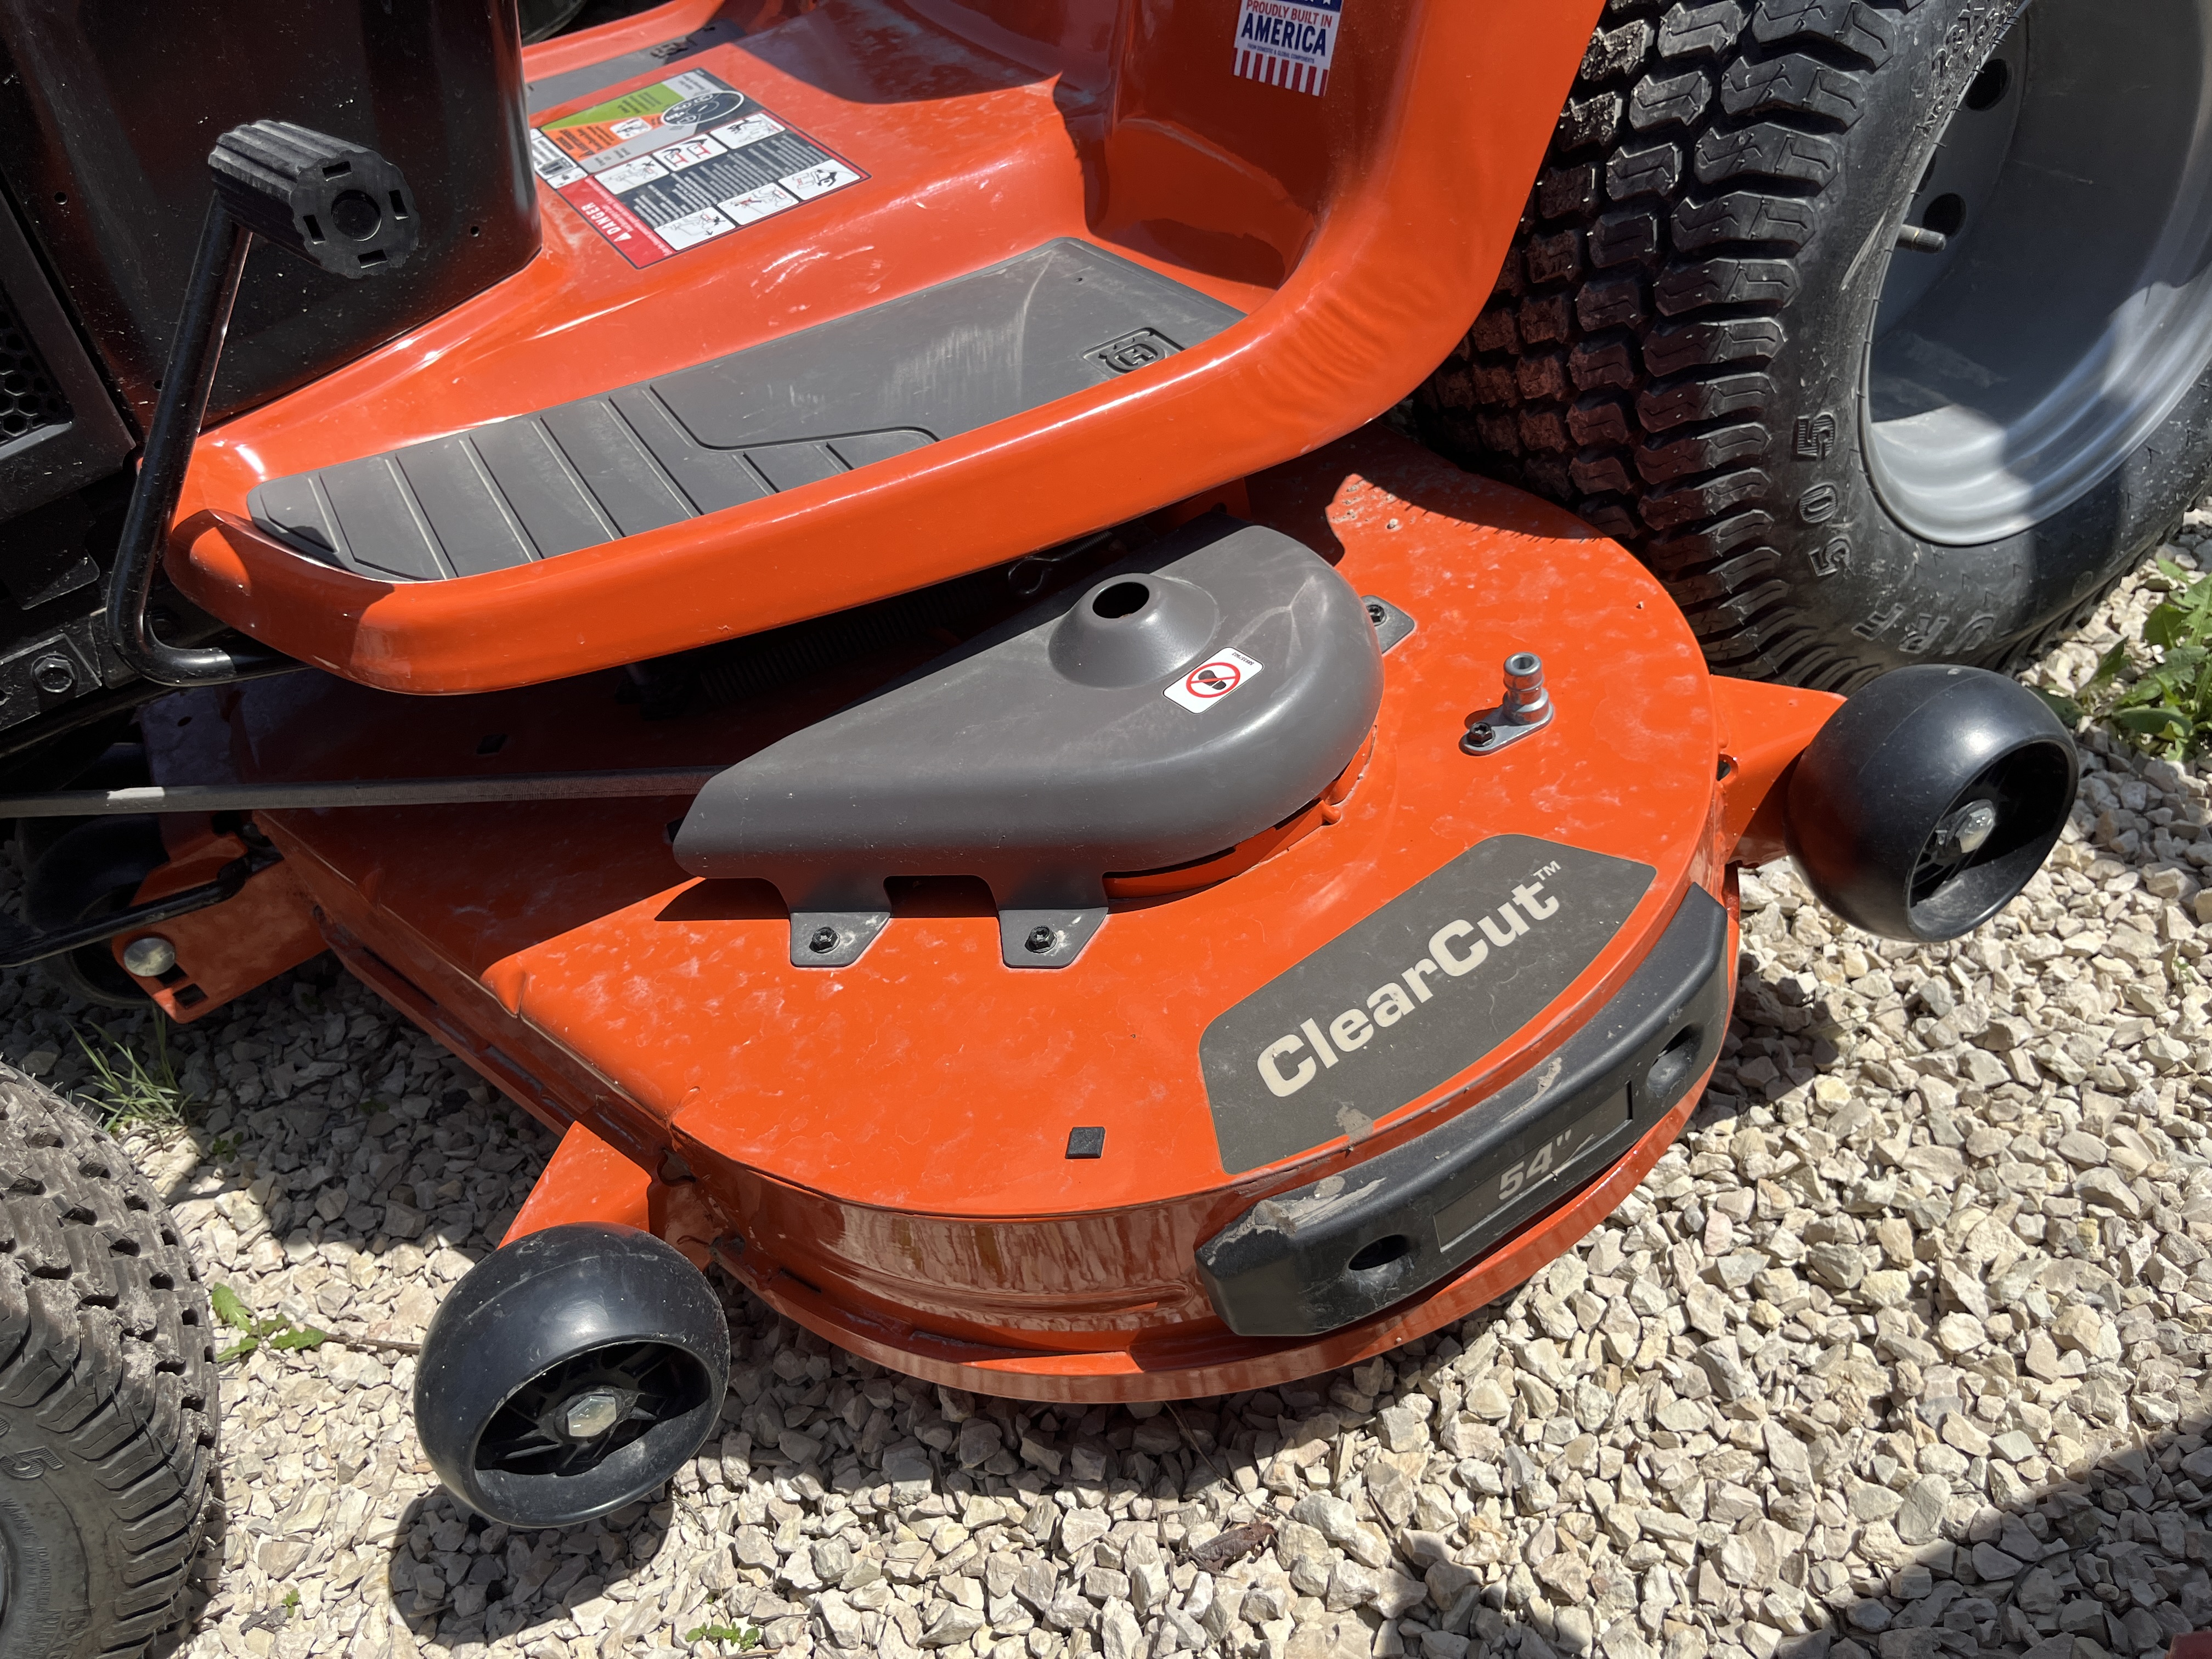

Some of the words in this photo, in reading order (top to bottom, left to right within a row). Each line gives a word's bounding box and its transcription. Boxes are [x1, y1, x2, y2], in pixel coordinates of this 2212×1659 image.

[1241, 13, 1325, 57] AMERICA
[1246, 0, 1289, 19] PROUDLY
[1291, 8, 1319, 25] BUILT
[1321, 14, 1333, 28] IN
[581, 202, 621, 236] DANGER
[1852, 603, 2009, 655] URF
[1498, 1129, 1572, 1201] 54"
